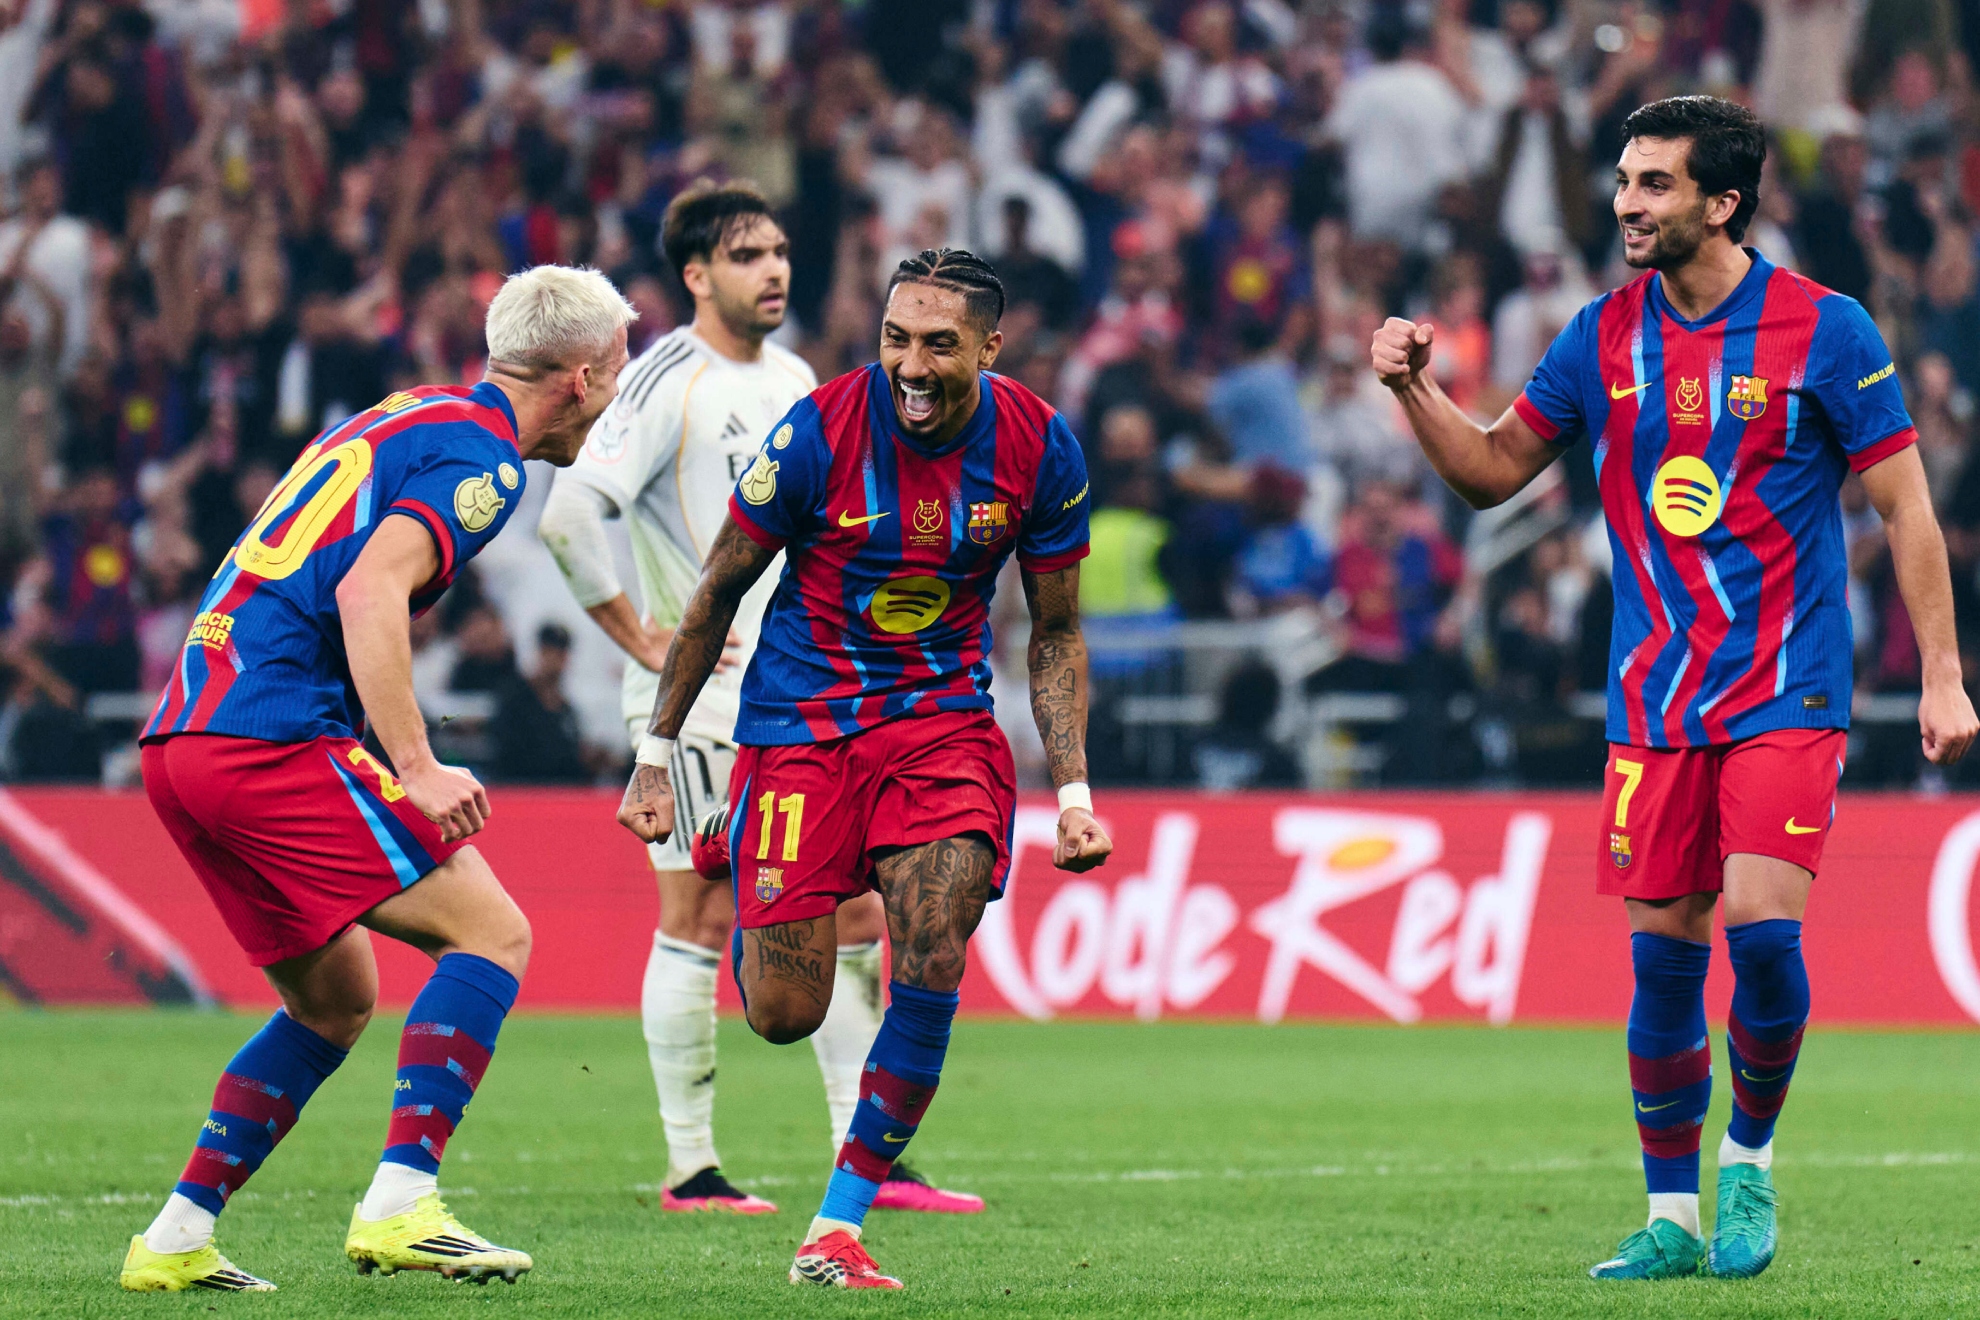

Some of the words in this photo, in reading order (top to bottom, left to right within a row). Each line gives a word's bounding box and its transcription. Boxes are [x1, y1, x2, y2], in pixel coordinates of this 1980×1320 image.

[194, 611, 235, 632] HCR
[346, 746, 407, 803] 2
[1614, 757, 1645, 829] 7
[756, 790, 806, 862] 11
[972, 806, 1240, 1022] Code
[1250, 806, 1554, 1024] Red
